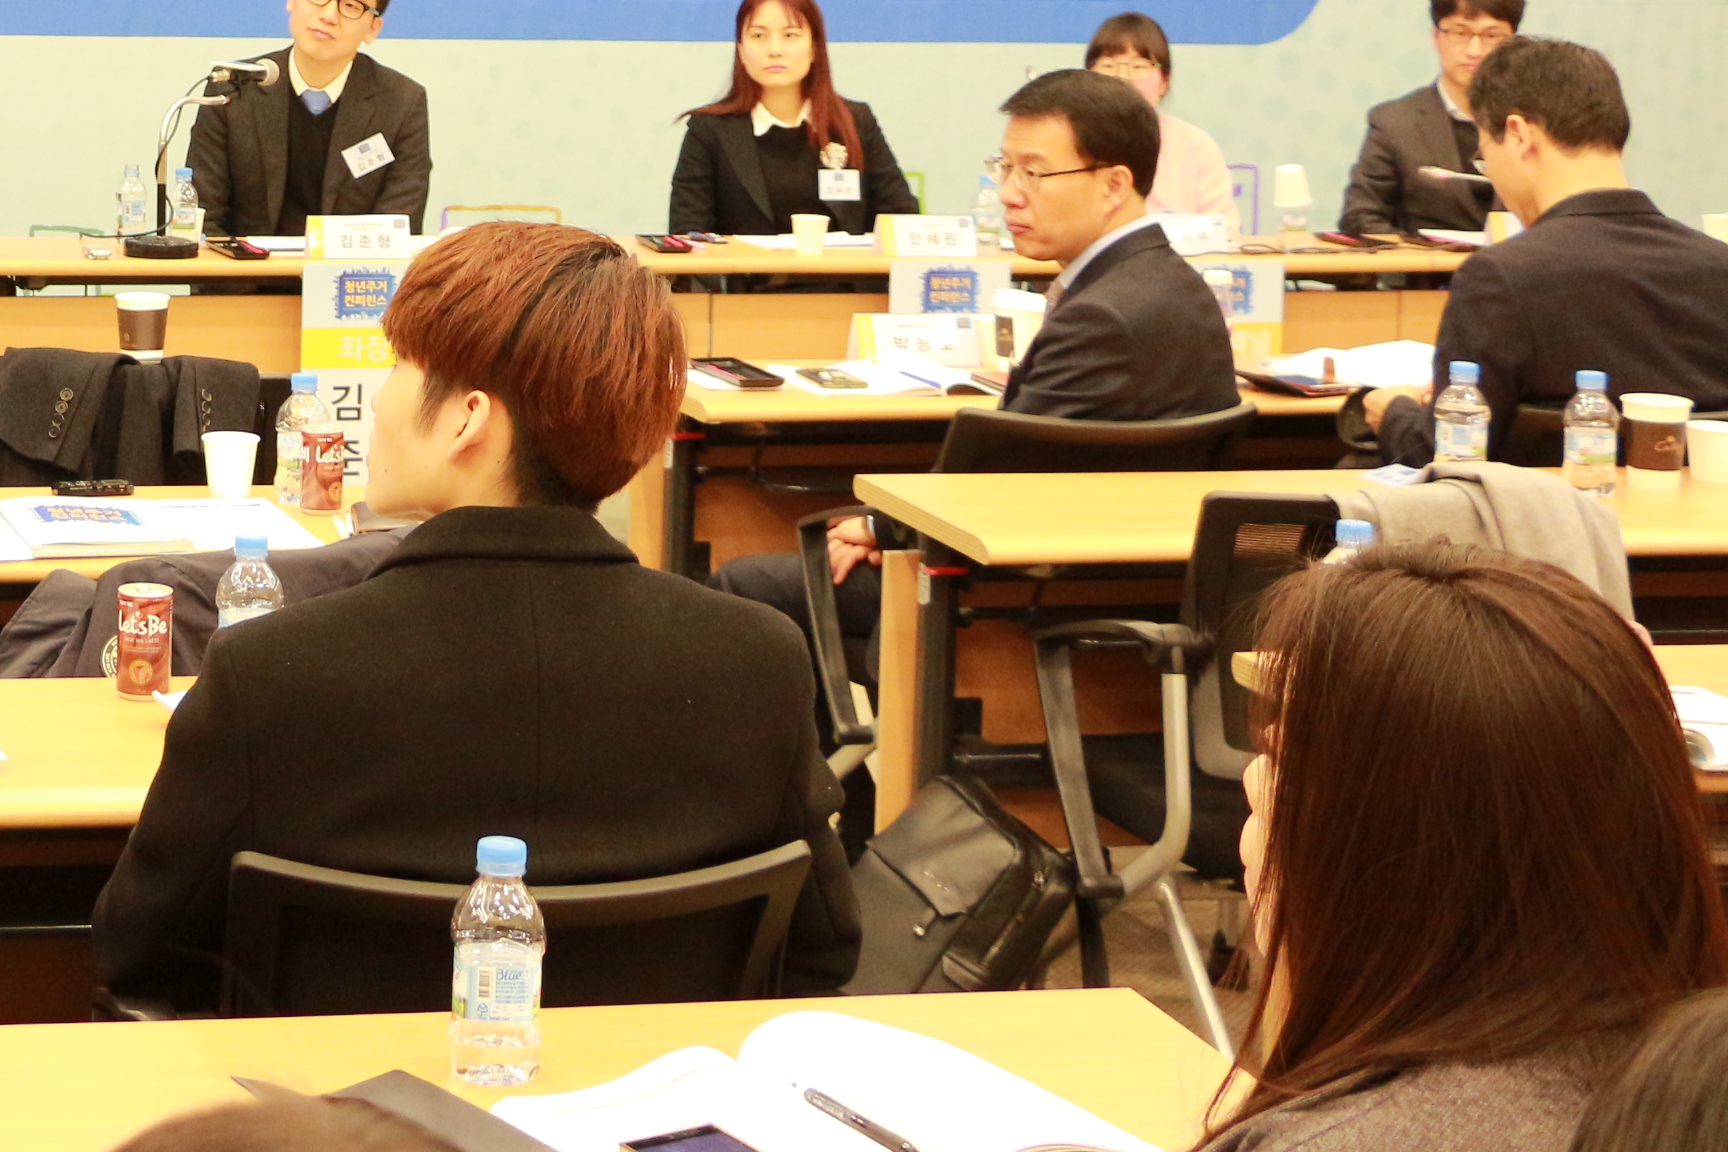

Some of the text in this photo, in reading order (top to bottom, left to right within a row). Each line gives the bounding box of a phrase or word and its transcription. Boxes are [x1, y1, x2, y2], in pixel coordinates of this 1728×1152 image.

[340, 233, 391, 249] 김준형
[344, 280, 389, 294] 청년주거
[344, 294, 389, 308] 컨퍼런스
[496, 968, 523, 981] Blue
